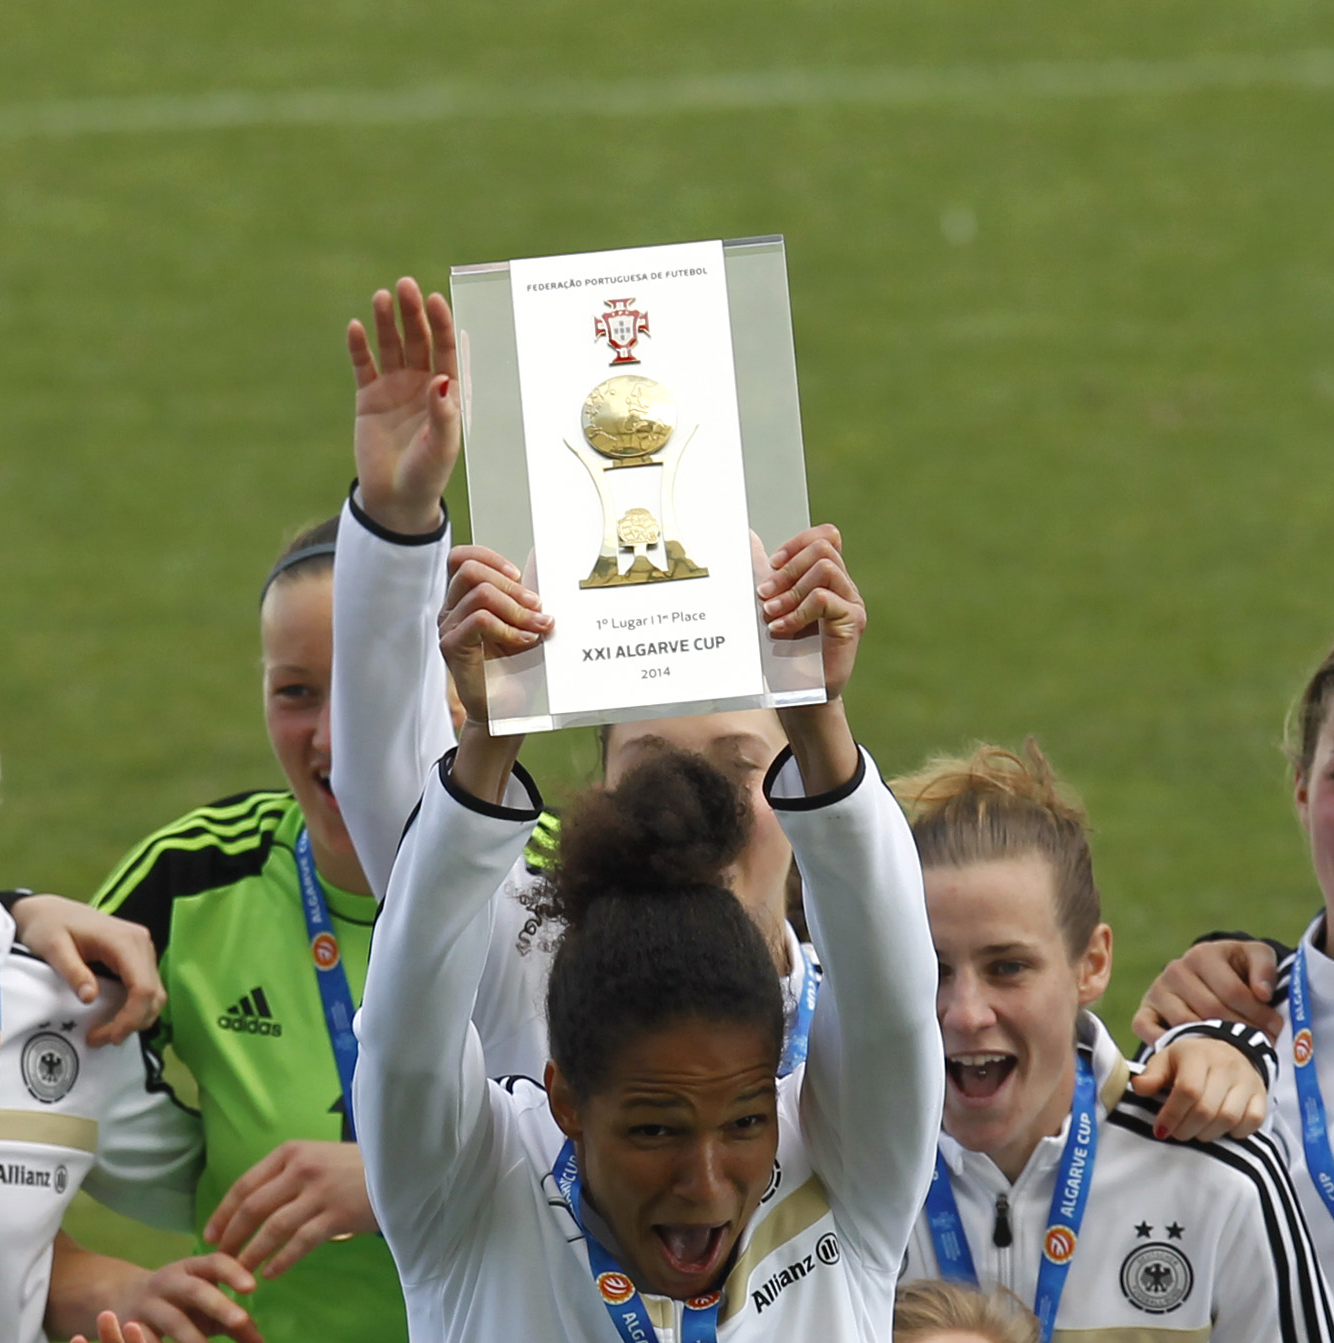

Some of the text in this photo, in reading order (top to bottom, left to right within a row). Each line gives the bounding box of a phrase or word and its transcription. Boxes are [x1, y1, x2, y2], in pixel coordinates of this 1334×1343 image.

[527, 267, 708, 292] FEDERAÇÃO PORTUGUESA DE FUTEBOL
[612, 617, 648, 630] Lugar
[672, 611, 706, 623] Place
[582, 635, 726, 661] XXI ALGARVE CUP
[641, 666, 671, 679] 2014
[218, 1014, 282, 1037] adidas
[1060, 1112, 1092, 1218] ALGARVE CUP
[750, 1254, 816, 1314] Allianz
